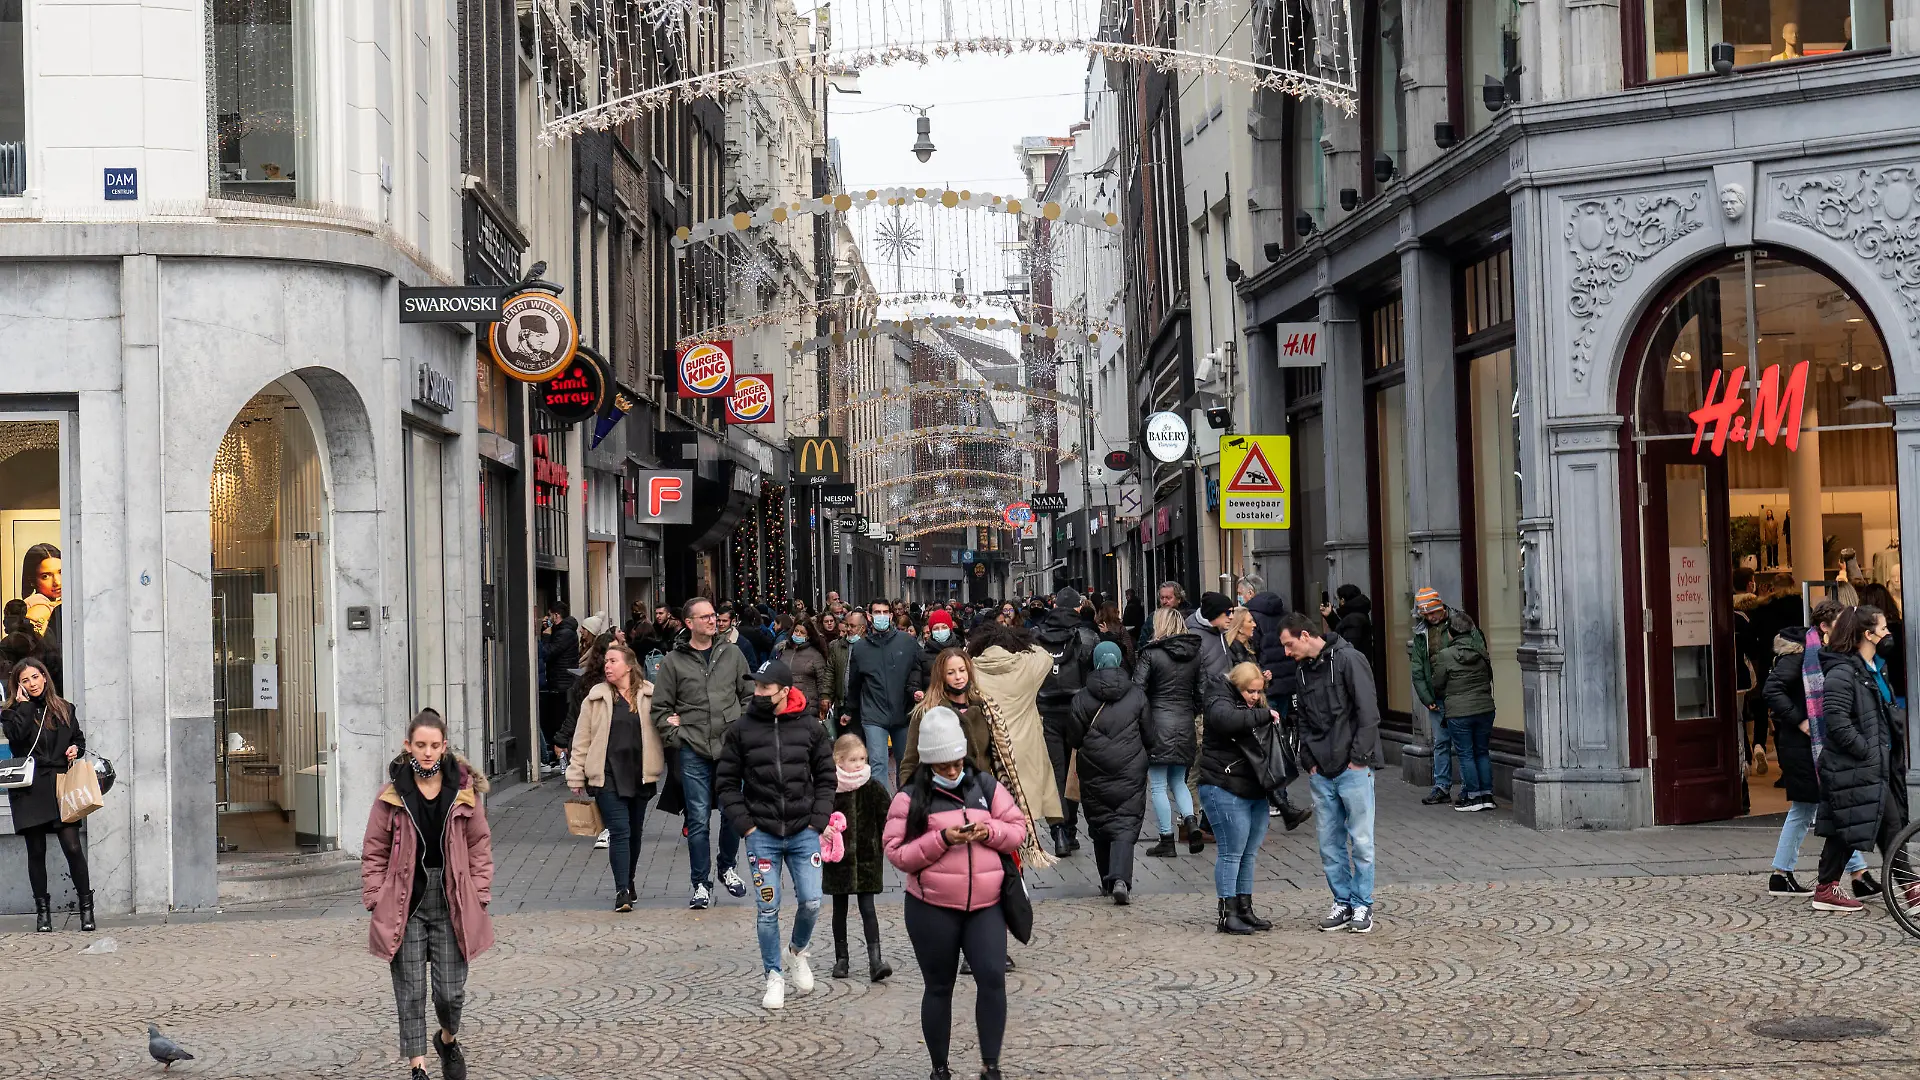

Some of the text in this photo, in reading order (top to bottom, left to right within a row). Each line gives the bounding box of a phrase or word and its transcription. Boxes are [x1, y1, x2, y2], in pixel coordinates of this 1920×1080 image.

[107, 173, 134, 186] DAM
[405, 296, 497, 313] SWAROVSKI
[500, 300, 563, 326] HENRI WILLIG
[1283, 332, 1317, 357] H&M
[514, 357, 555, 370] SINCE 1974
[685, 351, 724, 373] BURGER
[551, 367, 589, 391] simit
[688, 361, 726, 386] KING
[733, 392, 767, 412] KING
[1688, 360, 1810, 457] H&M
[1148, 431, 1187, 441] BAKERY
[648, 476, 683, 517] F
[1033, 496, 1064, 506] NANA
[1229, 499, 1281, 510] beweegbaar
[1236, 511, 1273, 519] obstakel
[832, 519, 840, 554] MANFIELD
[1681, 556, 1696, 569] For
[1677, 572, 1702, 587] (y)our
[1676, 590, 1704, 604] safety.
